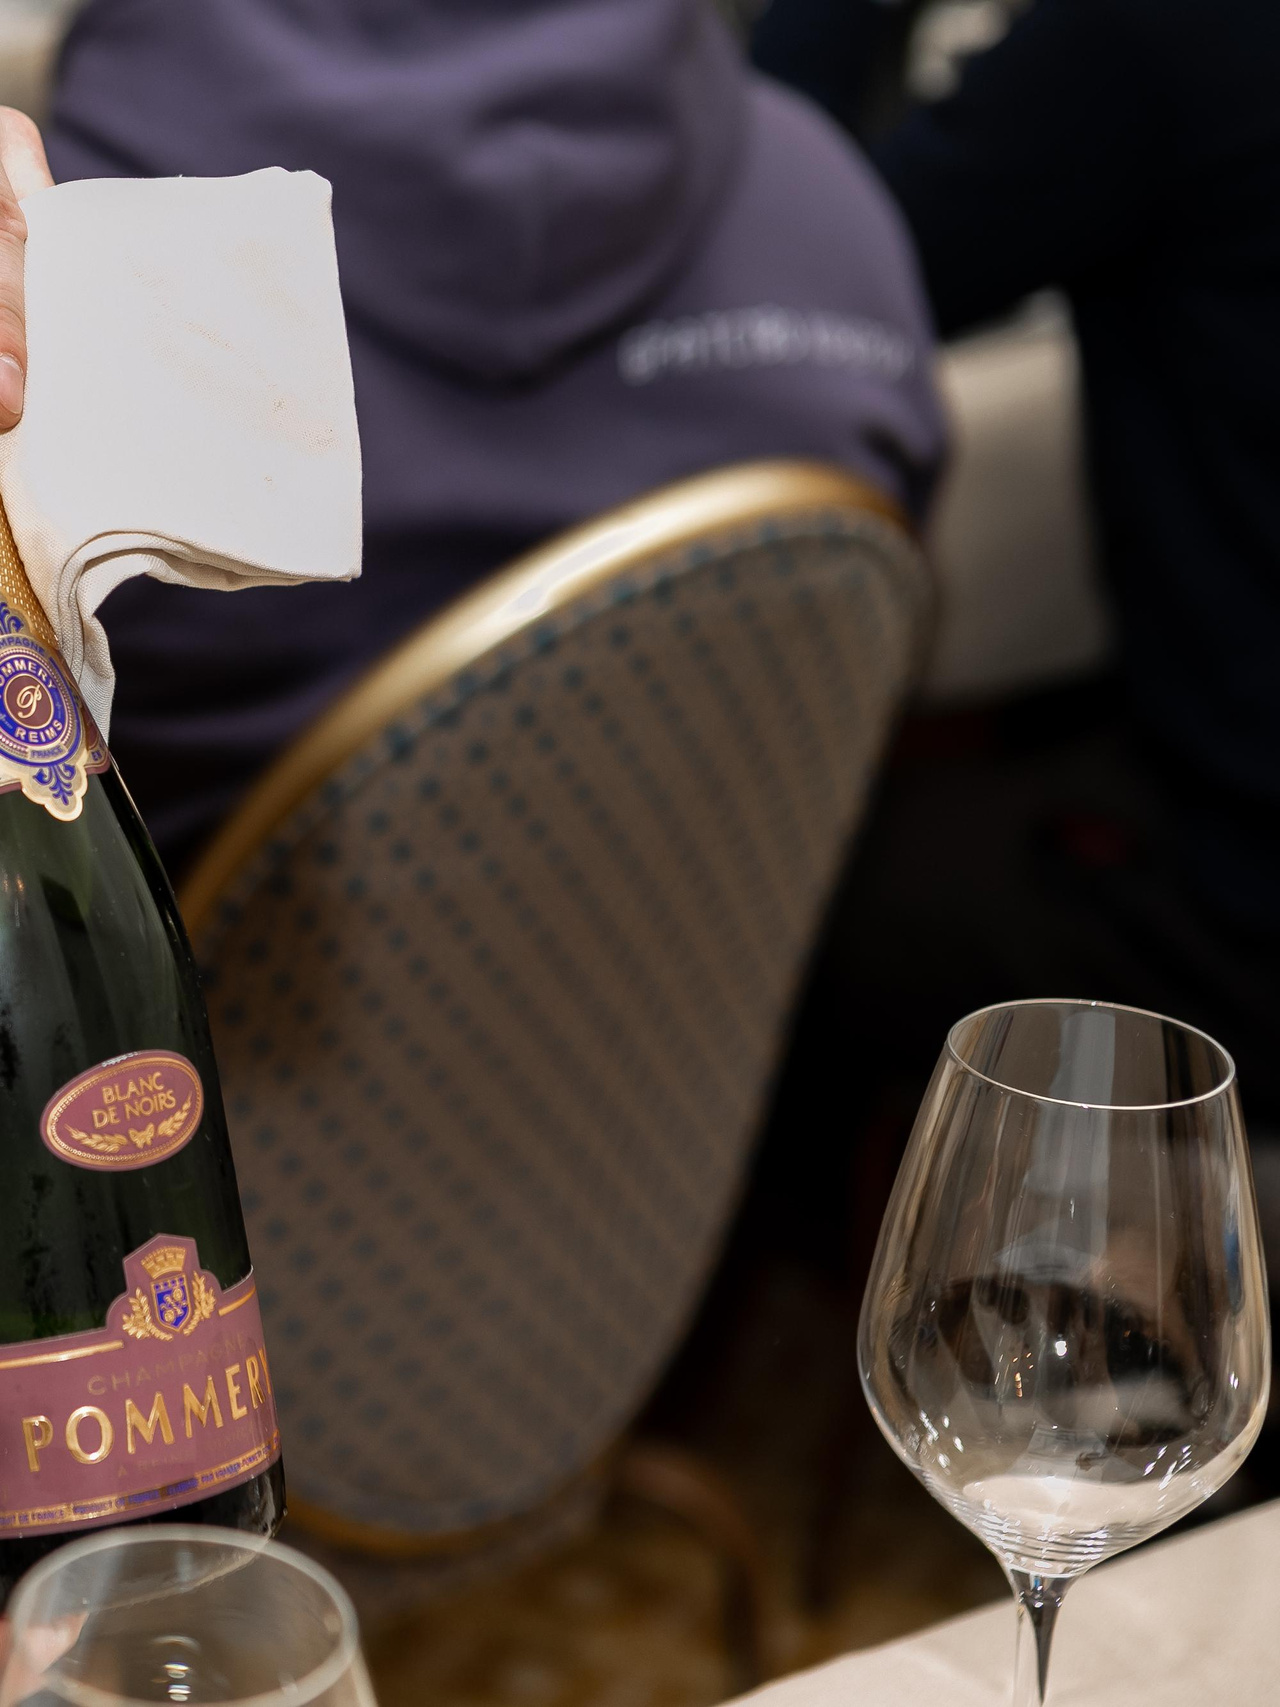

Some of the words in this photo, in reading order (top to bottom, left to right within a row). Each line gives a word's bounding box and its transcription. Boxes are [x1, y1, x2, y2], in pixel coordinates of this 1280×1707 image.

[14, 719, 63, 744] REIMS
[30, 745, 64, 759] FRANCE
[102, 1071, 164, 1104] BLANC
[92, 1106, 120, 1129] DE
[124, 1090, 176, 1120] NOIRS
[86, 1333, 247, 1396] CHAMPAGNE
